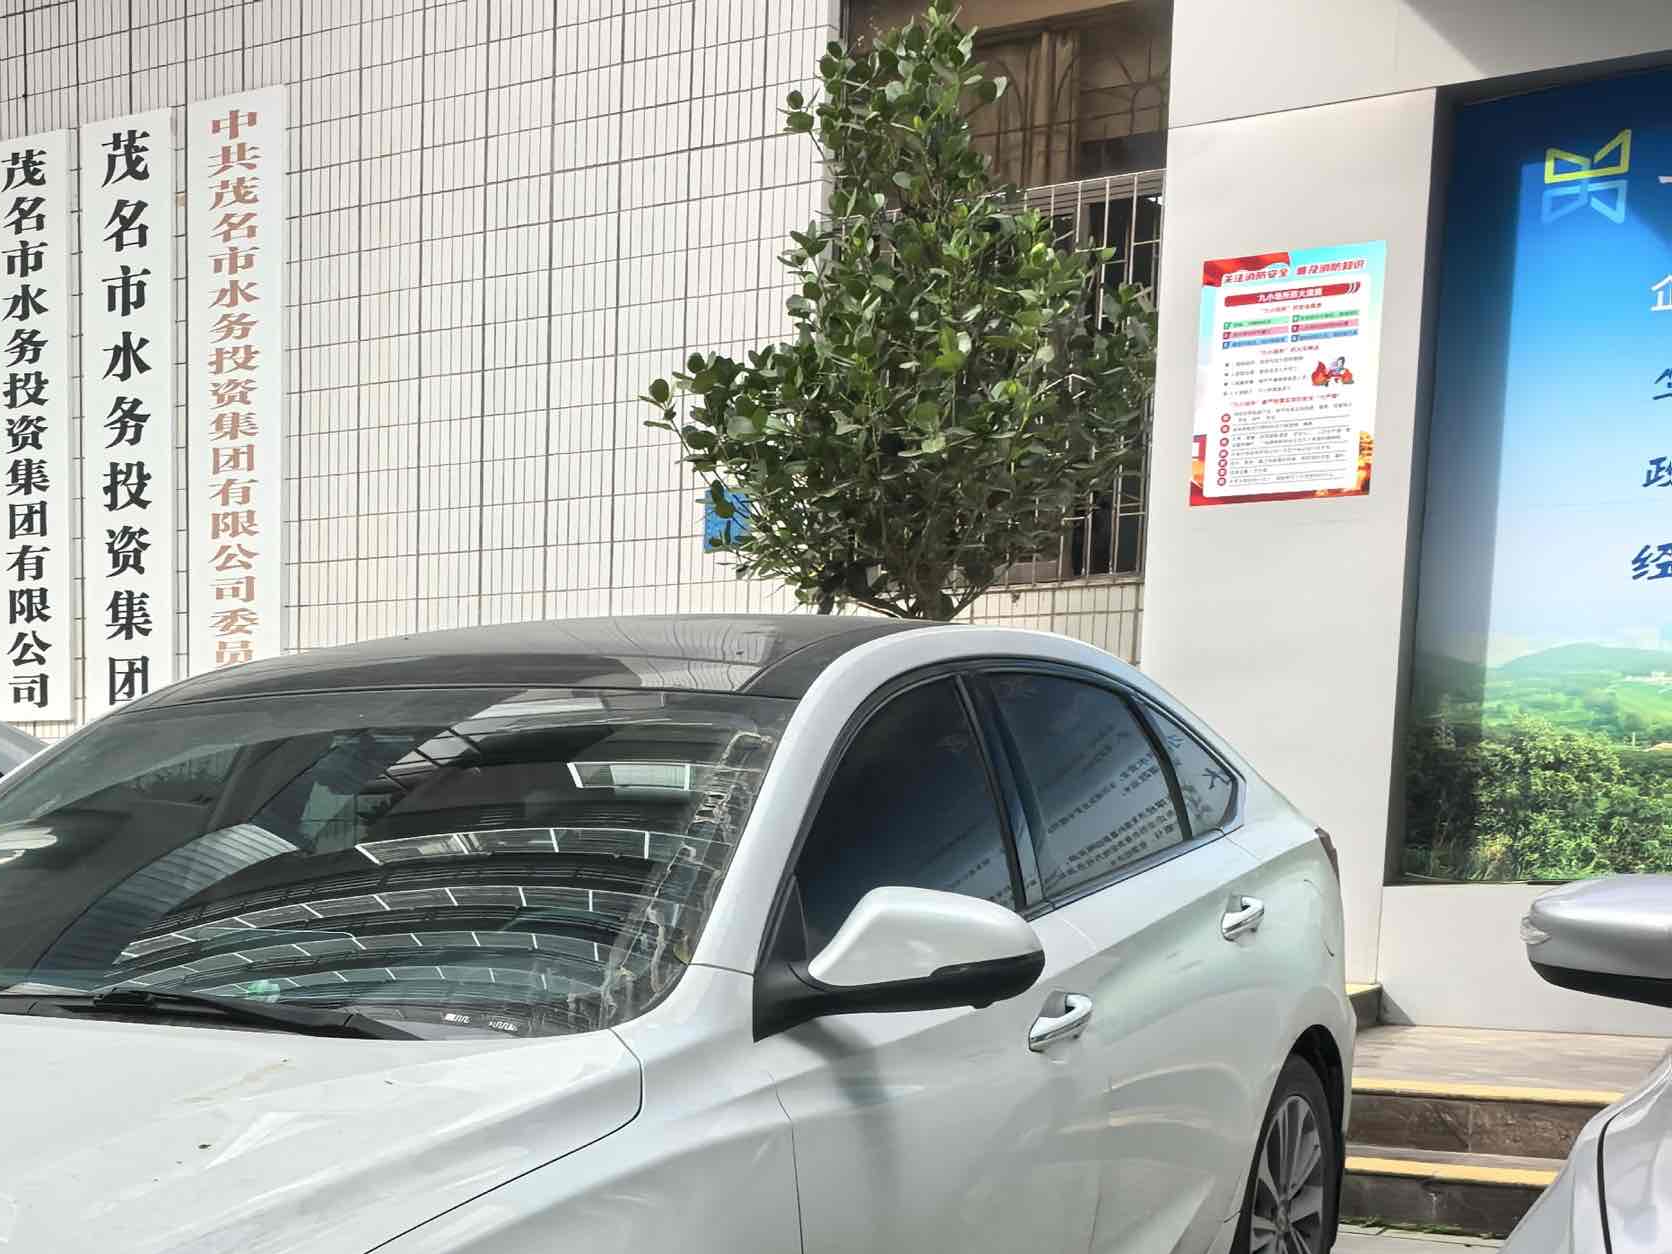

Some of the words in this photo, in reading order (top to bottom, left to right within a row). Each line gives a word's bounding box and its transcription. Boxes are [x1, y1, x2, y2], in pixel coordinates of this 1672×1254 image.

[0, 149, 52, 708] 茂名市水务投资集团有限公司
[101, 129, 152, 706] 茂名市水务投资集团
[208, 109, 260, 667] 中共茂名市水务投资集团有限公司委员
